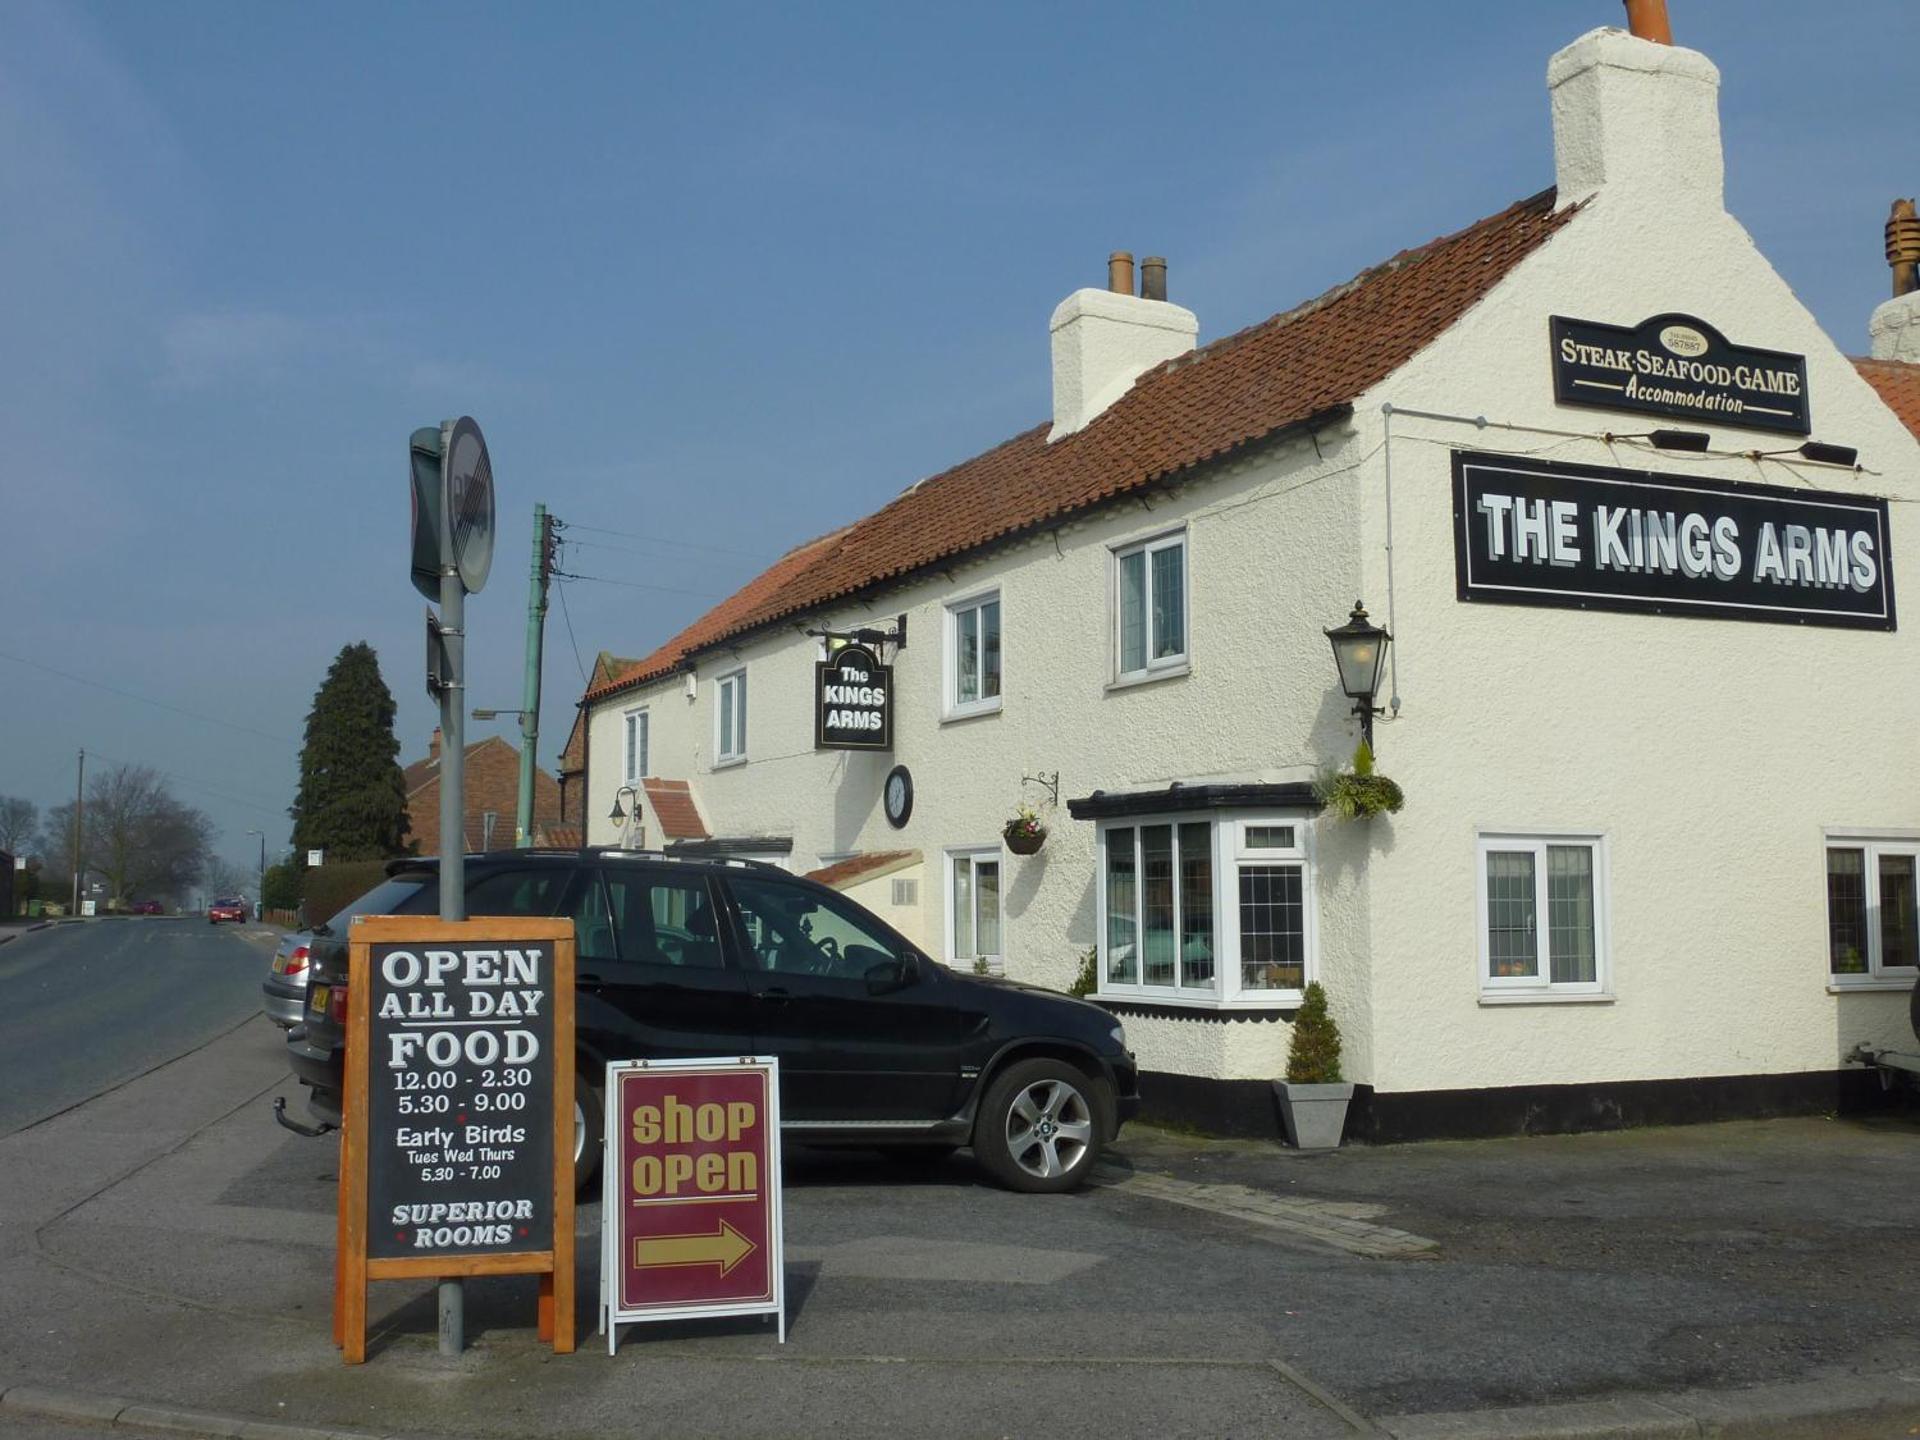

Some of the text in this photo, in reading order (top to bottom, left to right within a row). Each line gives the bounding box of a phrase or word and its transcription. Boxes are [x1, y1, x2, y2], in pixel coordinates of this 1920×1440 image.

[1625, 374, 1743, 413] Accommodation
[1477, 493, 1876, 593] THE KINGS ARMS
[841, 666, 869, 682] The
[823, 685, 885, 707] KINGS
[825, 709, 882, 730] ARMS
[382, 950, 543, 988] OPEN
[379, 990, 544, 1019] ALL DAY
[388, 1030, 540, 1068] FOOD
[394, 1071, 457, 1090] 12.00
[481, 1068, 532, 1087] 2.30
[398, 1095, 449, 1114] 5.30
[474, 1092, 525, 1111] 9.00
[633, 1095, 756, 1144] shop
[396, 1124, 525, 1149] Early Birds
[407, 1147, 515, 1164] Tues Wed Thurs
[421, 1167, 454, 1182] 5.30
[469, 1165, 501, 1179] 7.00
[633, 1152, 757, 1195] open
[392, 1199, 534, 1225] SUPERIOR
[414, 1224, 513, 1248] ROOMS
